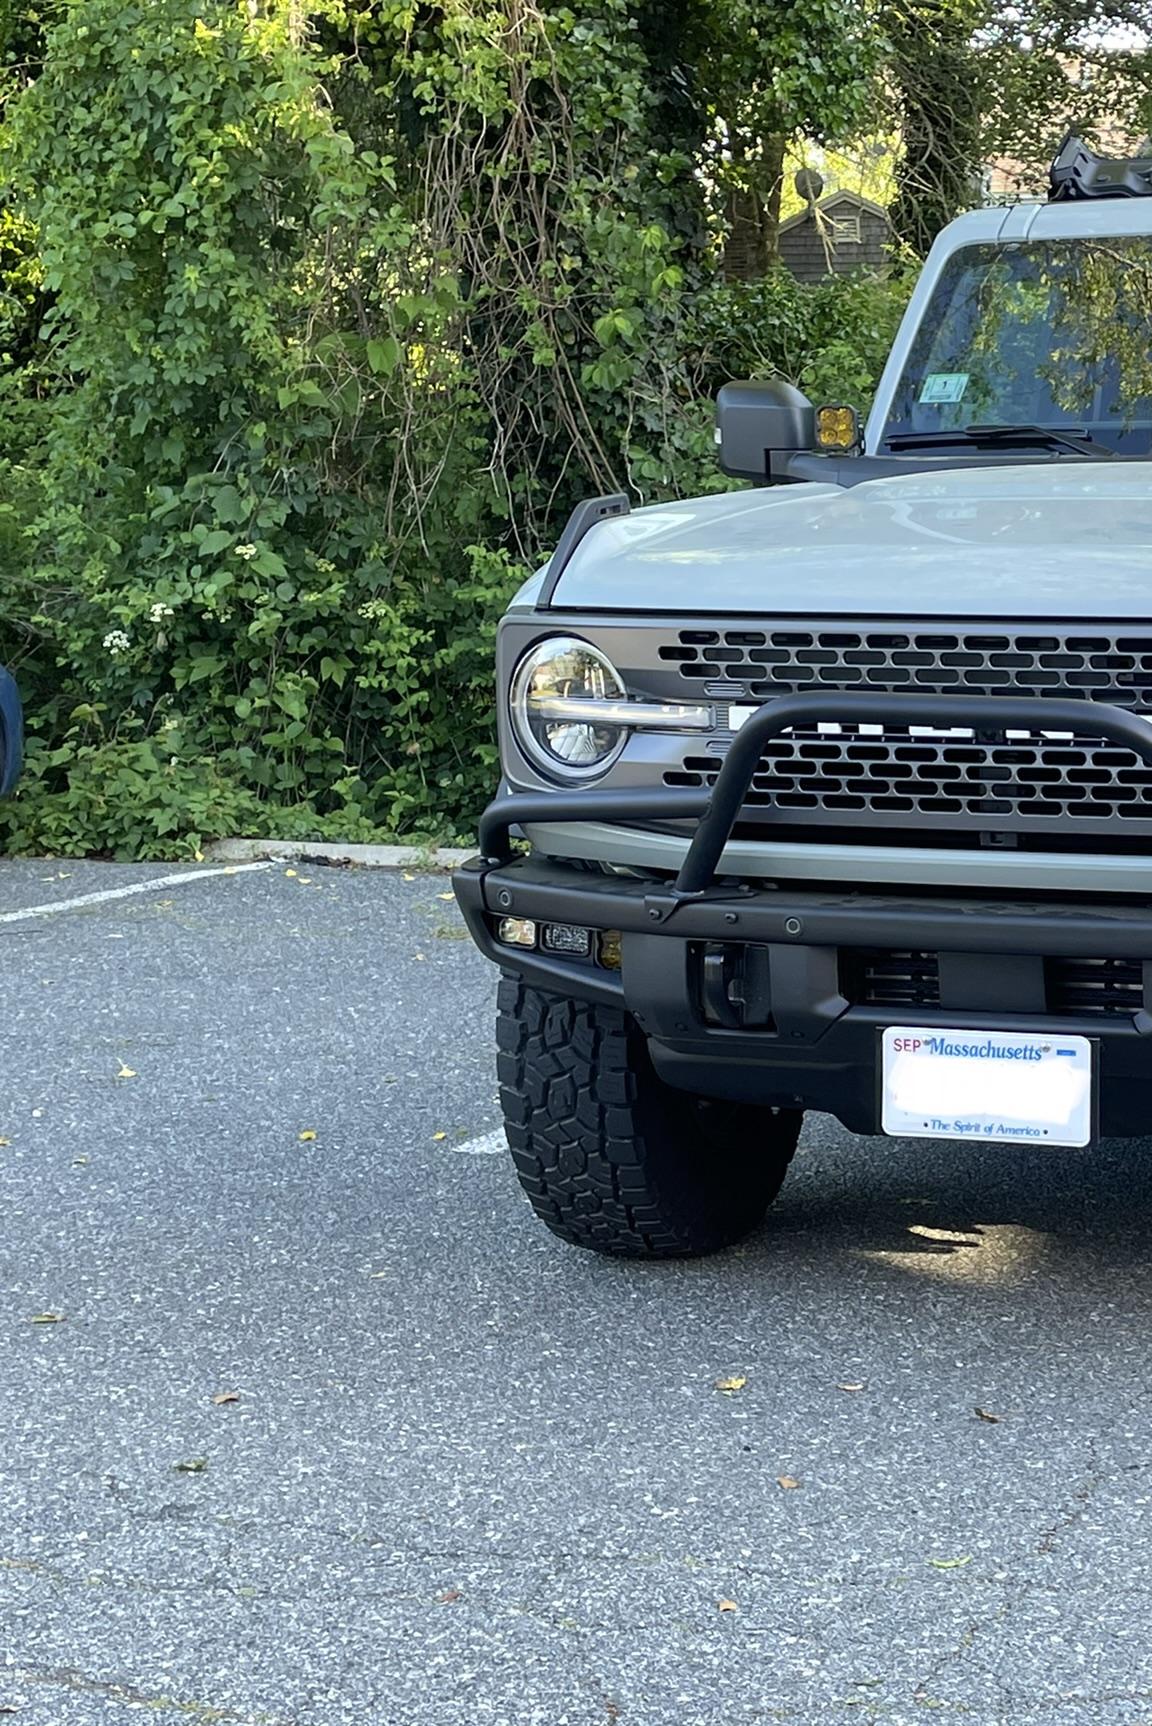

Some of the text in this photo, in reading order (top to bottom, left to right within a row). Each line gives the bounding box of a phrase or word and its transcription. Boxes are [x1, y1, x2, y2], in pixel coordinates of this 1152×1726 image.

[893, 1038, 921, 1052] SEP
[930, 1037, 1043, 1061] Massachusetts
[931, 1119, 1040, 1137] The Spirit of America
